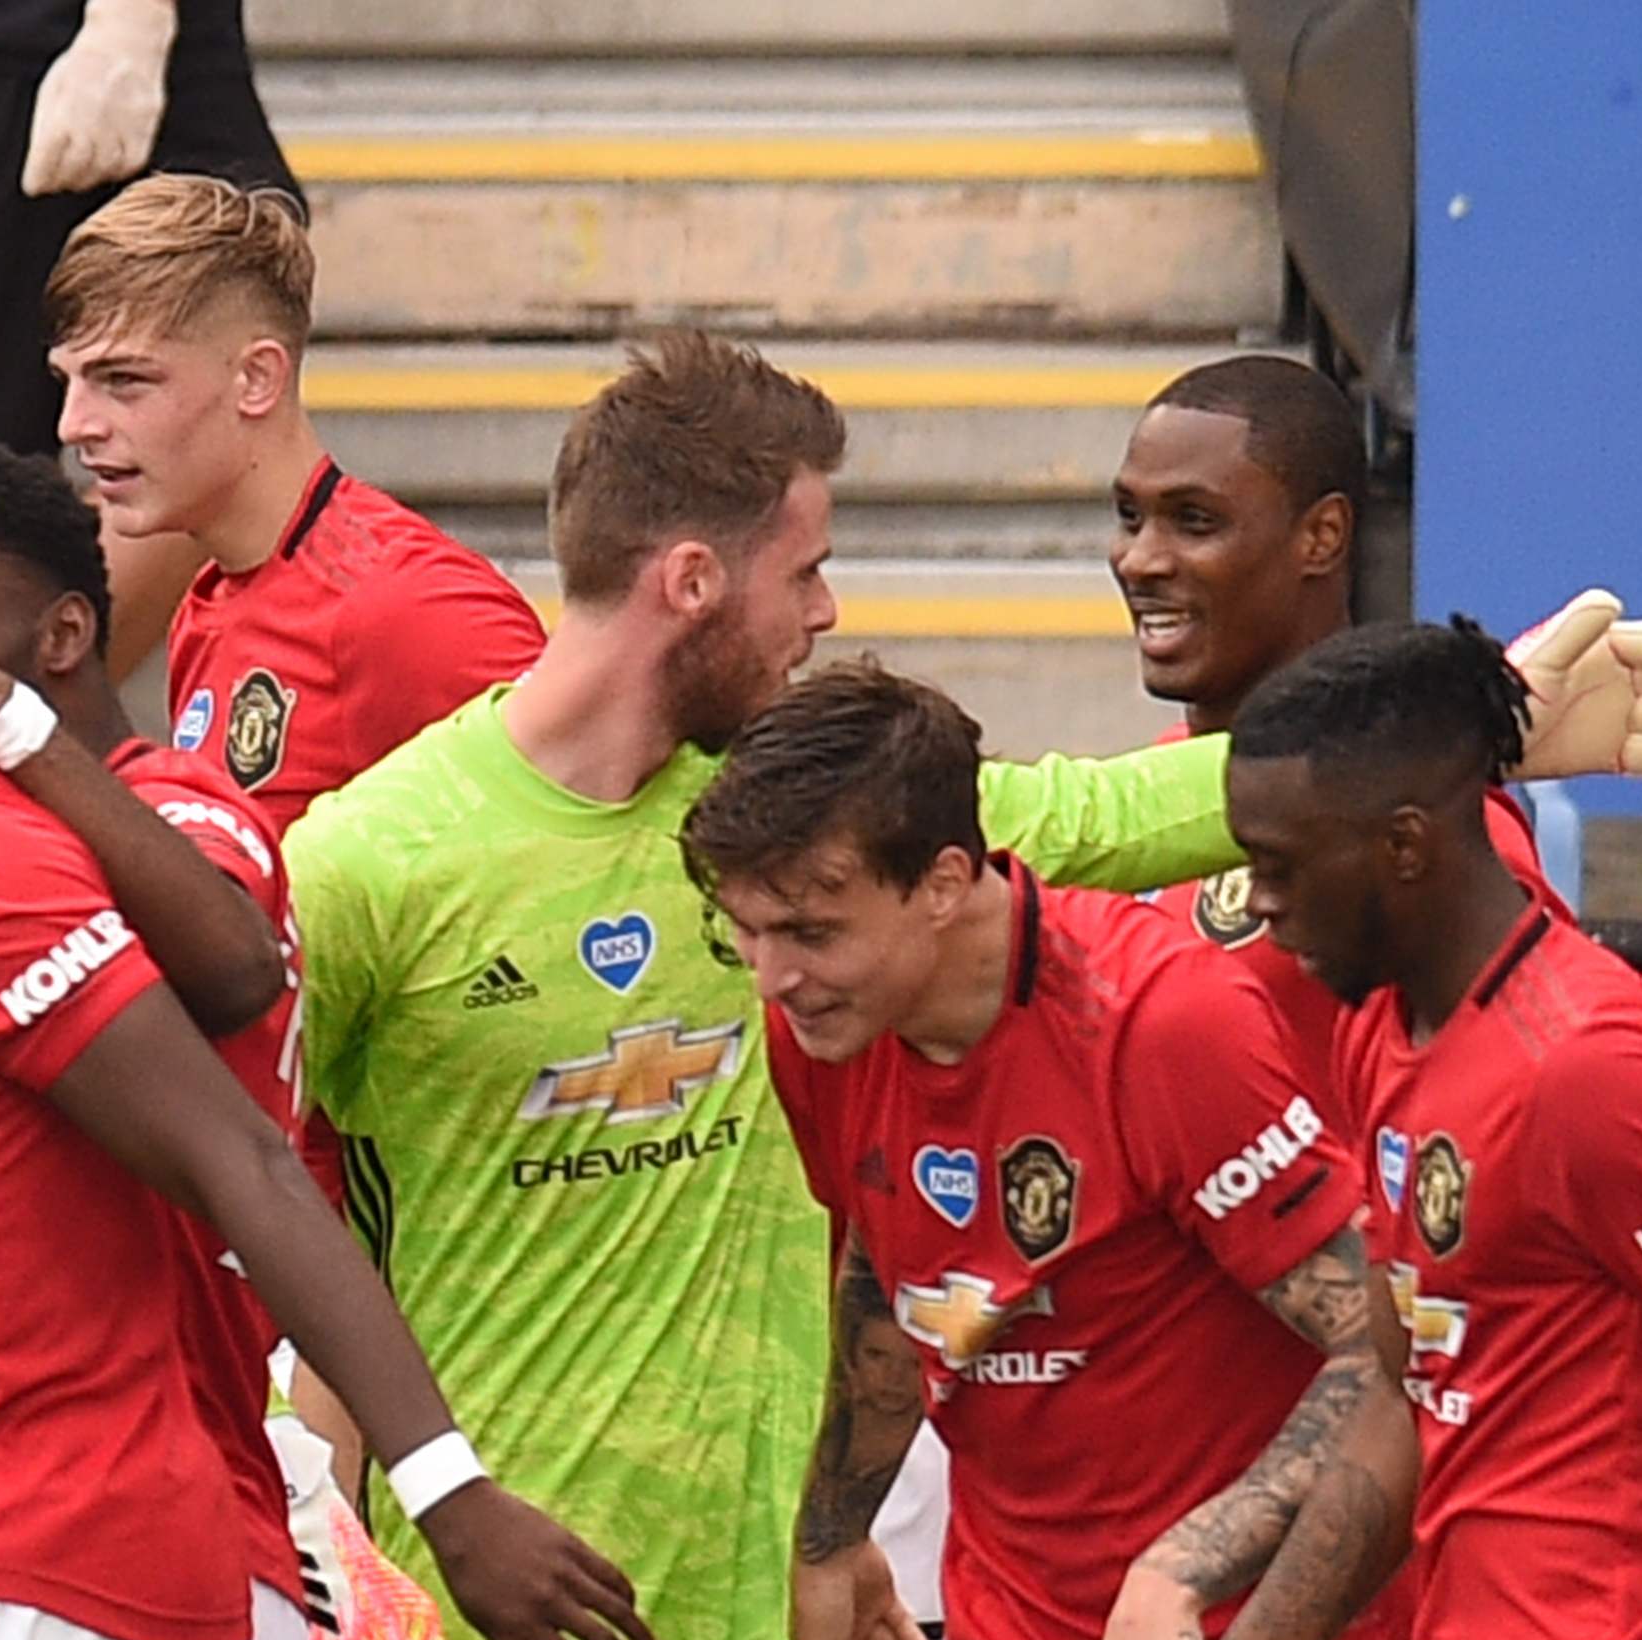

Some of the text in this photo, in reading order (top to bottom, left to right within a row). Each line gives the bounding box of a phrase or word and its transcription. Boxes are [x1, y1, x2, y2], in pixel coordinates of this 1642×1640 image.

[596, 936, 638, 962] NHS
[462, 983, 539, 1009] adidas
[512, 1115, 743, 1188] CHEVROLET
[932, 1172, 971, 1194] NHS
